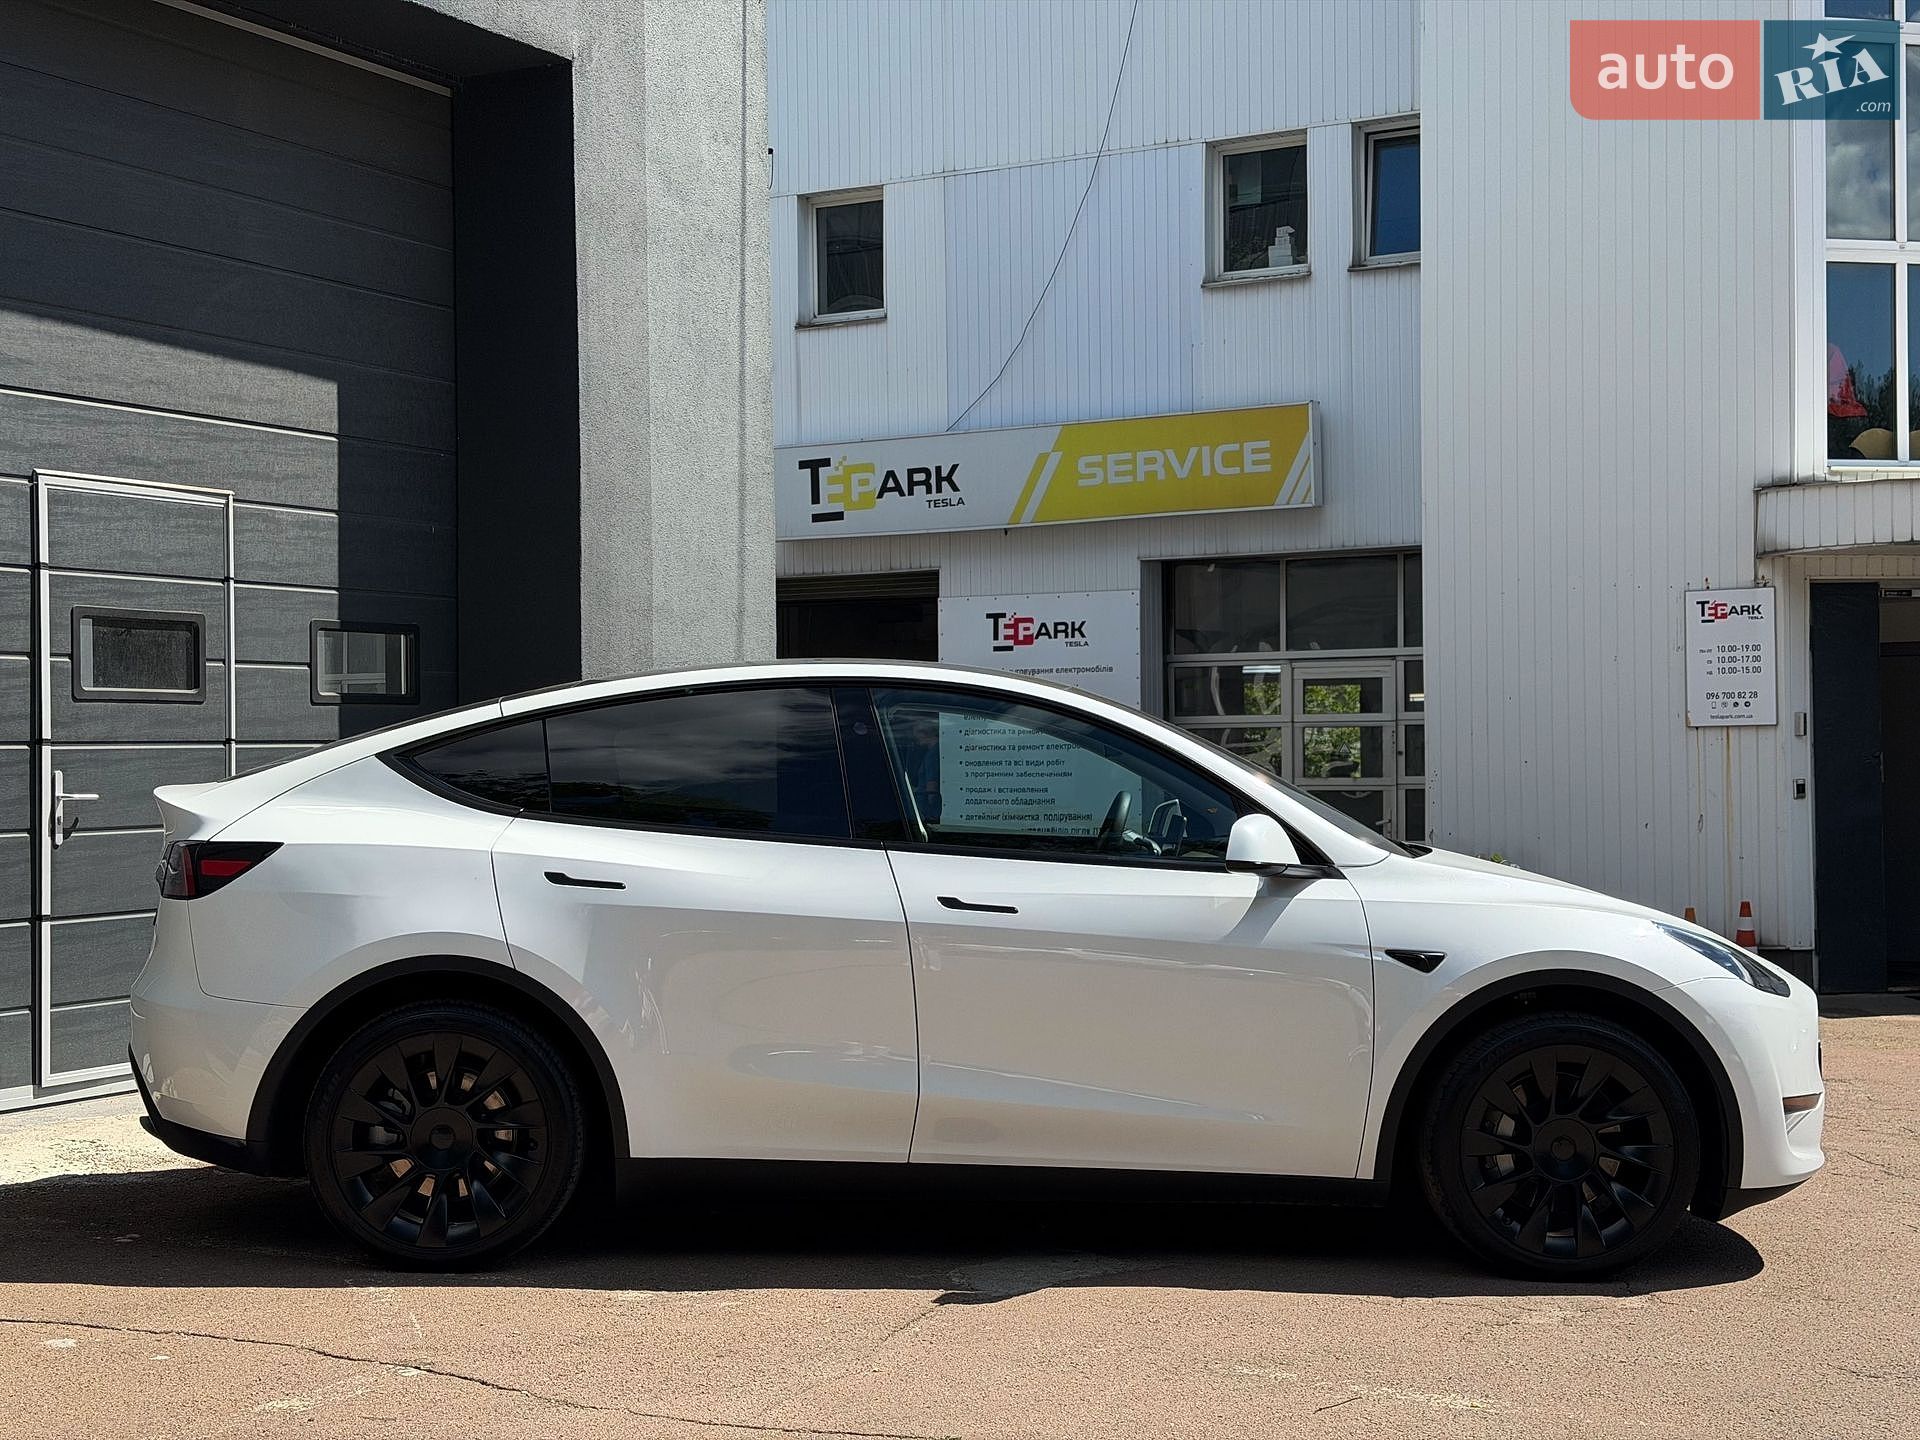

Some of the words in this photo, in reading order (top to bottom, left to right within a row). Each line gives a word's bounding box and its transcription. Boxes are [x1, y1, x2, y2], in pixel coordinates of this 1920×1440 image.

[1077, 440, 1272, 487] SERVICE
[926, 497, 966, 509] TESLA
[1716, 644, 1761, 653] 10.00-19.00
[1717, 655, 1762, 664] 10.00-17.00
[1055, 665, 1114, 675] електромобілів
[1717, 665, 1762, 675] 10.00-15.00
[1706, 691, 1720, 700] 096
[1721, 691, 1735, 700] 700
[1737, 691, 1747, 699] 82
[1748, 690, 1758, 699] 28
[964, 744, 1007, 752] діагностика
[1018, 744, 1044, 752] ремонт
[1046, 759, 1065, 767] робіт
[1010, 797, 1056, 806] обладнання
